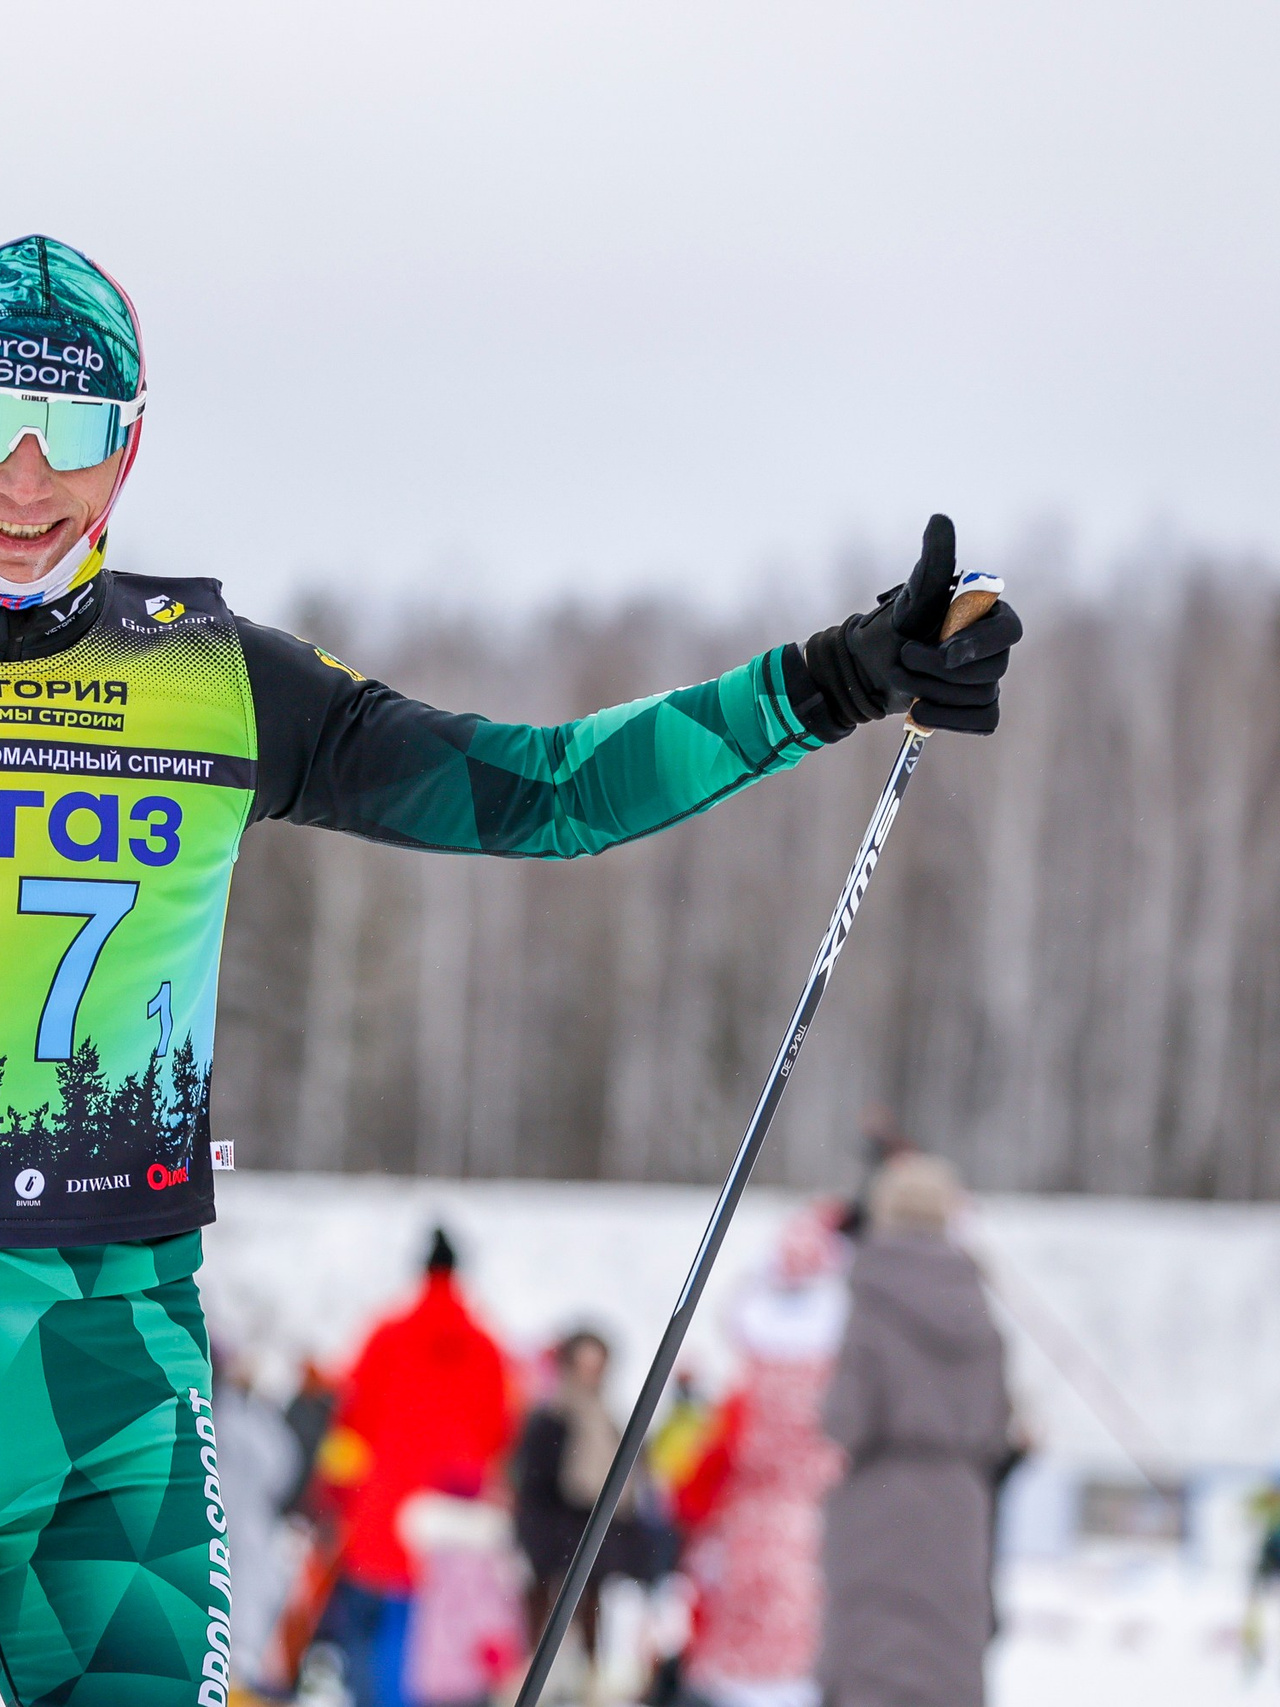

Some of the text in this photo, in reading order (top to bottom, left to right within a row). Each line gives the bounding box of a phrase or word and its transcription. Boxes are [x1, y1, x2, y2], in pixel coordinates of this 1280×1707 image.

[44, 597, 95, 636] VICTORY CODE
[38, 710, 122, 729] строим
[128, 755, 215, 778] СПРИНТ
[147, 980, 174, 1059] 1
[66, 1174, 132, 1193] DIWARI
[15, 1199, 41, 1207] BIVIUM
